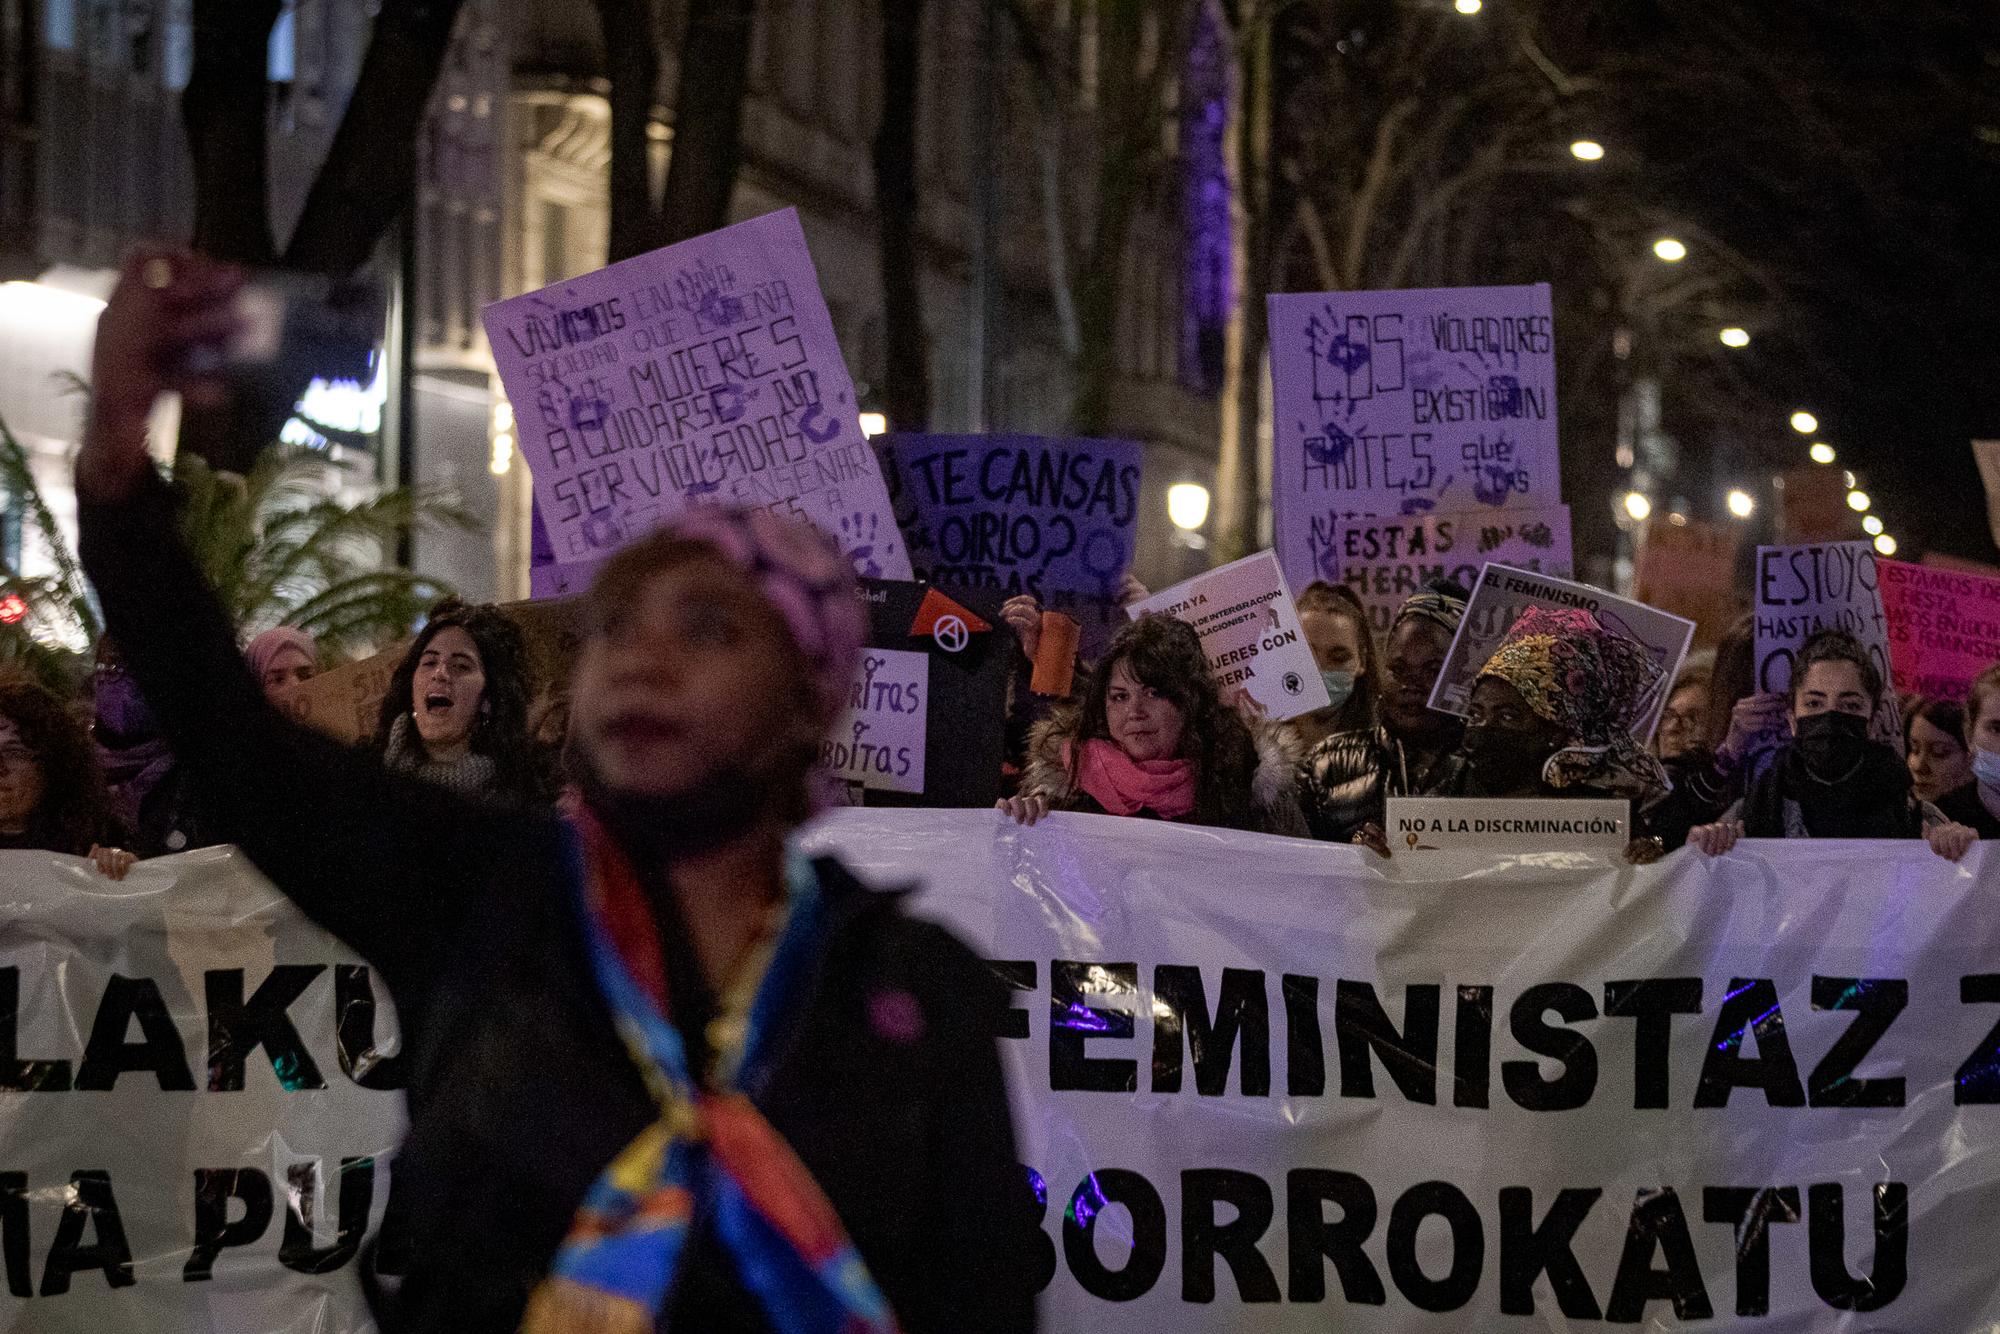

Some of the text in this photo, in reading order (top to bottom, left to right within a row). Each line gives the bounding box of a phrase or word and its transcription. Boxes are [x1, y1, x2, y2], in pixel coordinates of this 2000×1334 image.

[772, 368, 820, 417] NO
[553, 461, 633, 523] SER
[979, 447, 1140, 527] CANSAS
[1344, 521, 1454, 559] ESTAS
[1484, 572, 1600, 612] EL FEMINISMO
[1761, 545, 1854, 606] ESTOY
[1190, 594, 1208, 606] YA
[1209, 590, 1283, 623] INTERGRACION
[1261, 630, 1297, 651] CON
[1400, 817, 1617, 834] NO A LA DISCRMINACIÓN
